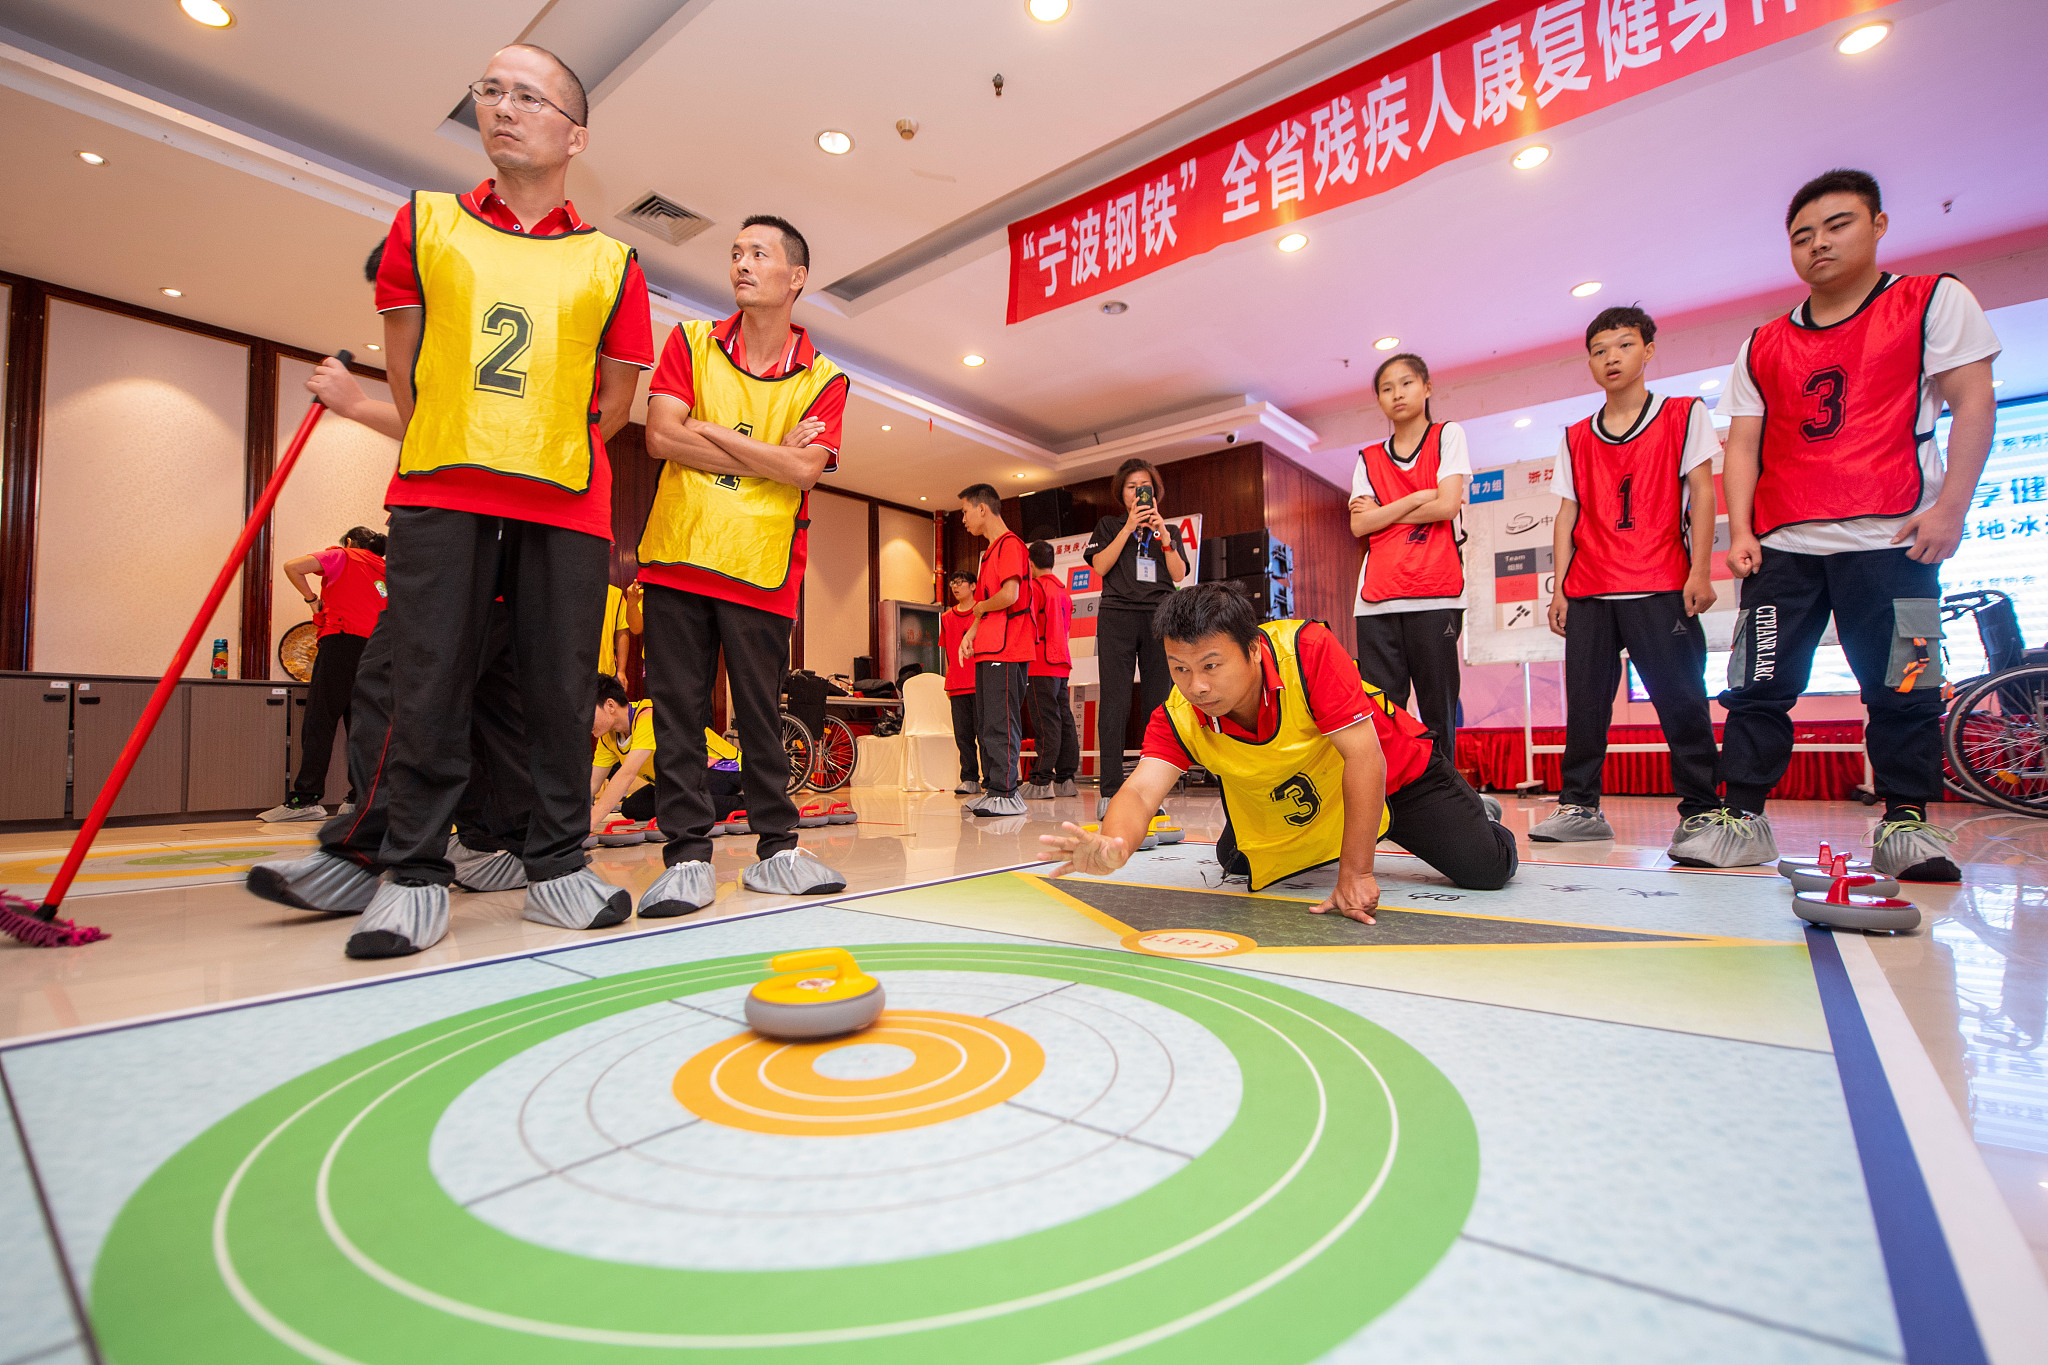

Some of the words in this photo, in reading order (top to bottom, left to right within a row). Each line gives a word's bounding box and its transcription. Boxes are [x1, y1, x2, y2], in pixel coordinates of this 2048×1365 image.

[1023, 157, 1197, 298] “宁波钢铁”
[1222, 0, 1797, 224] 全省残疾人康复健身
[474, 302, 533, 399] 2
[1800, 364, 1848, 443] 3
[1471, 479, 1502, 495] 智力组
[1615, 473, 1635, 531] 1
[1504, 554, 1526, 562] Team
[1087, 602, 1093, 612] 6
[1269, 771, 1322, 827] 3
[1142, 934, 1236, 950] start
